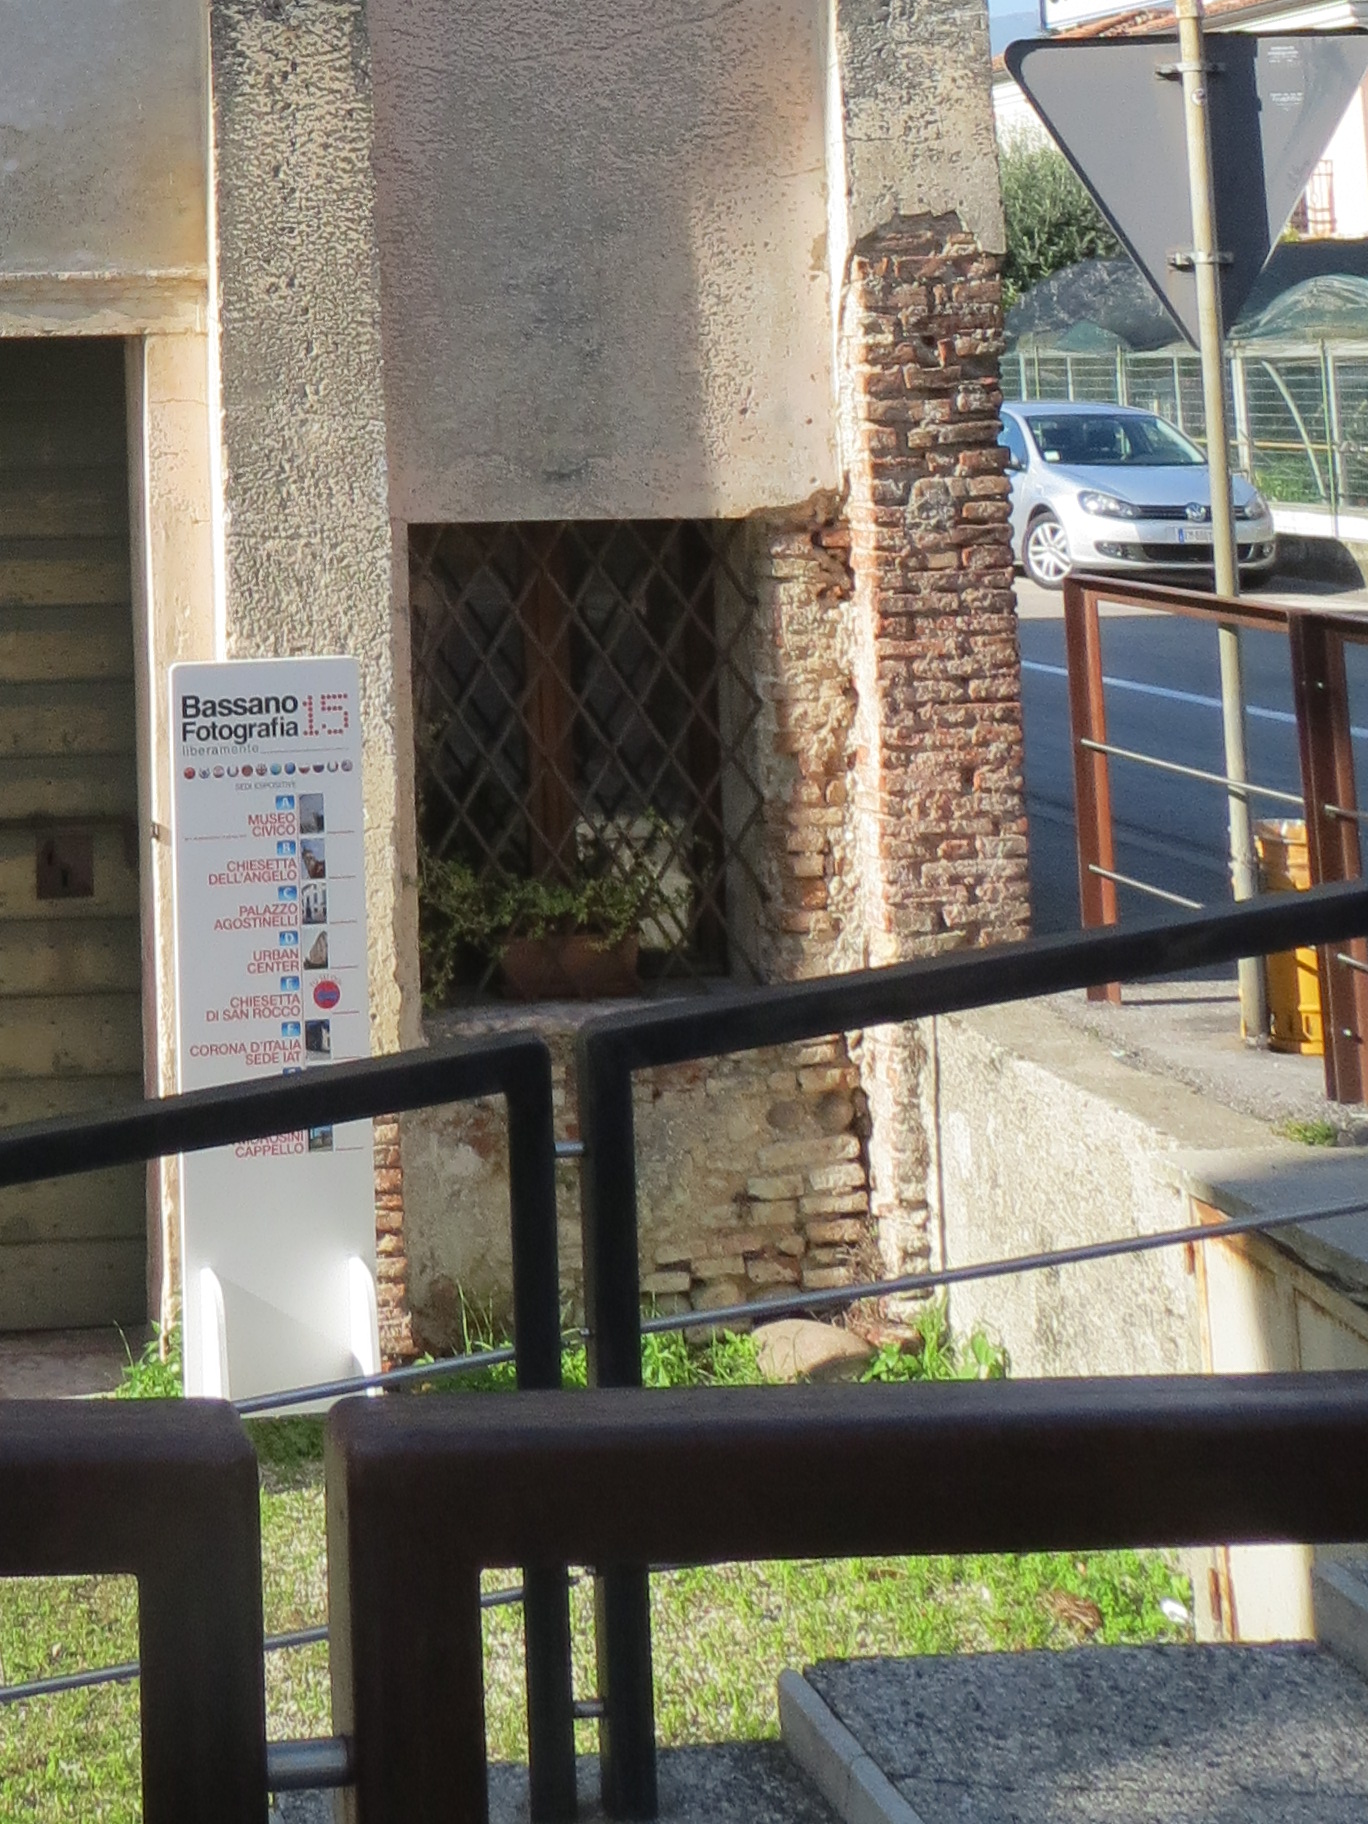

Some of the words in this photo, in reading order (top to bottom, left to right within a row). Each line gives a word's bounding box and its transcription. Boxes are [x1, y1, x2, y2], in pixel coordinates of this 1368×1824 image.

[181, 694, 299, 718] Bassano
[302, 693, 349, 736] 15
[181, 716, 299, 744] Fotografia
[248, 812, 295, 826] MUSEO
[252, 825, 296, 838] CIVICO
[226, 857, 297, 873] CHIESETTA
[208, 870, 297, 886] DELL'ANGELO
[239, 903, 298, 917] PALAZZO
[213, 915, 298, 931] AGOSTINELLI
[252, 948, 299, 963] URBAN
[247, 960, 300, 975] CENTER
[229, 993, 301, 1009] CHIESETTA
[206, 1009, 219, 1023] DI
[222, 1008, 249, 1022] SAN
[252, 1005, 301, 1020] ROCCO
[189, 1042, 248, 1057] CORONA
[250, 1038, 302, 1054] D'ITALIA
[245, 1052, 280, 1066] SEDE
[282, 1050, 301, 1064] IAT
[235, 1142, 304, 1158] CAPPELLO
